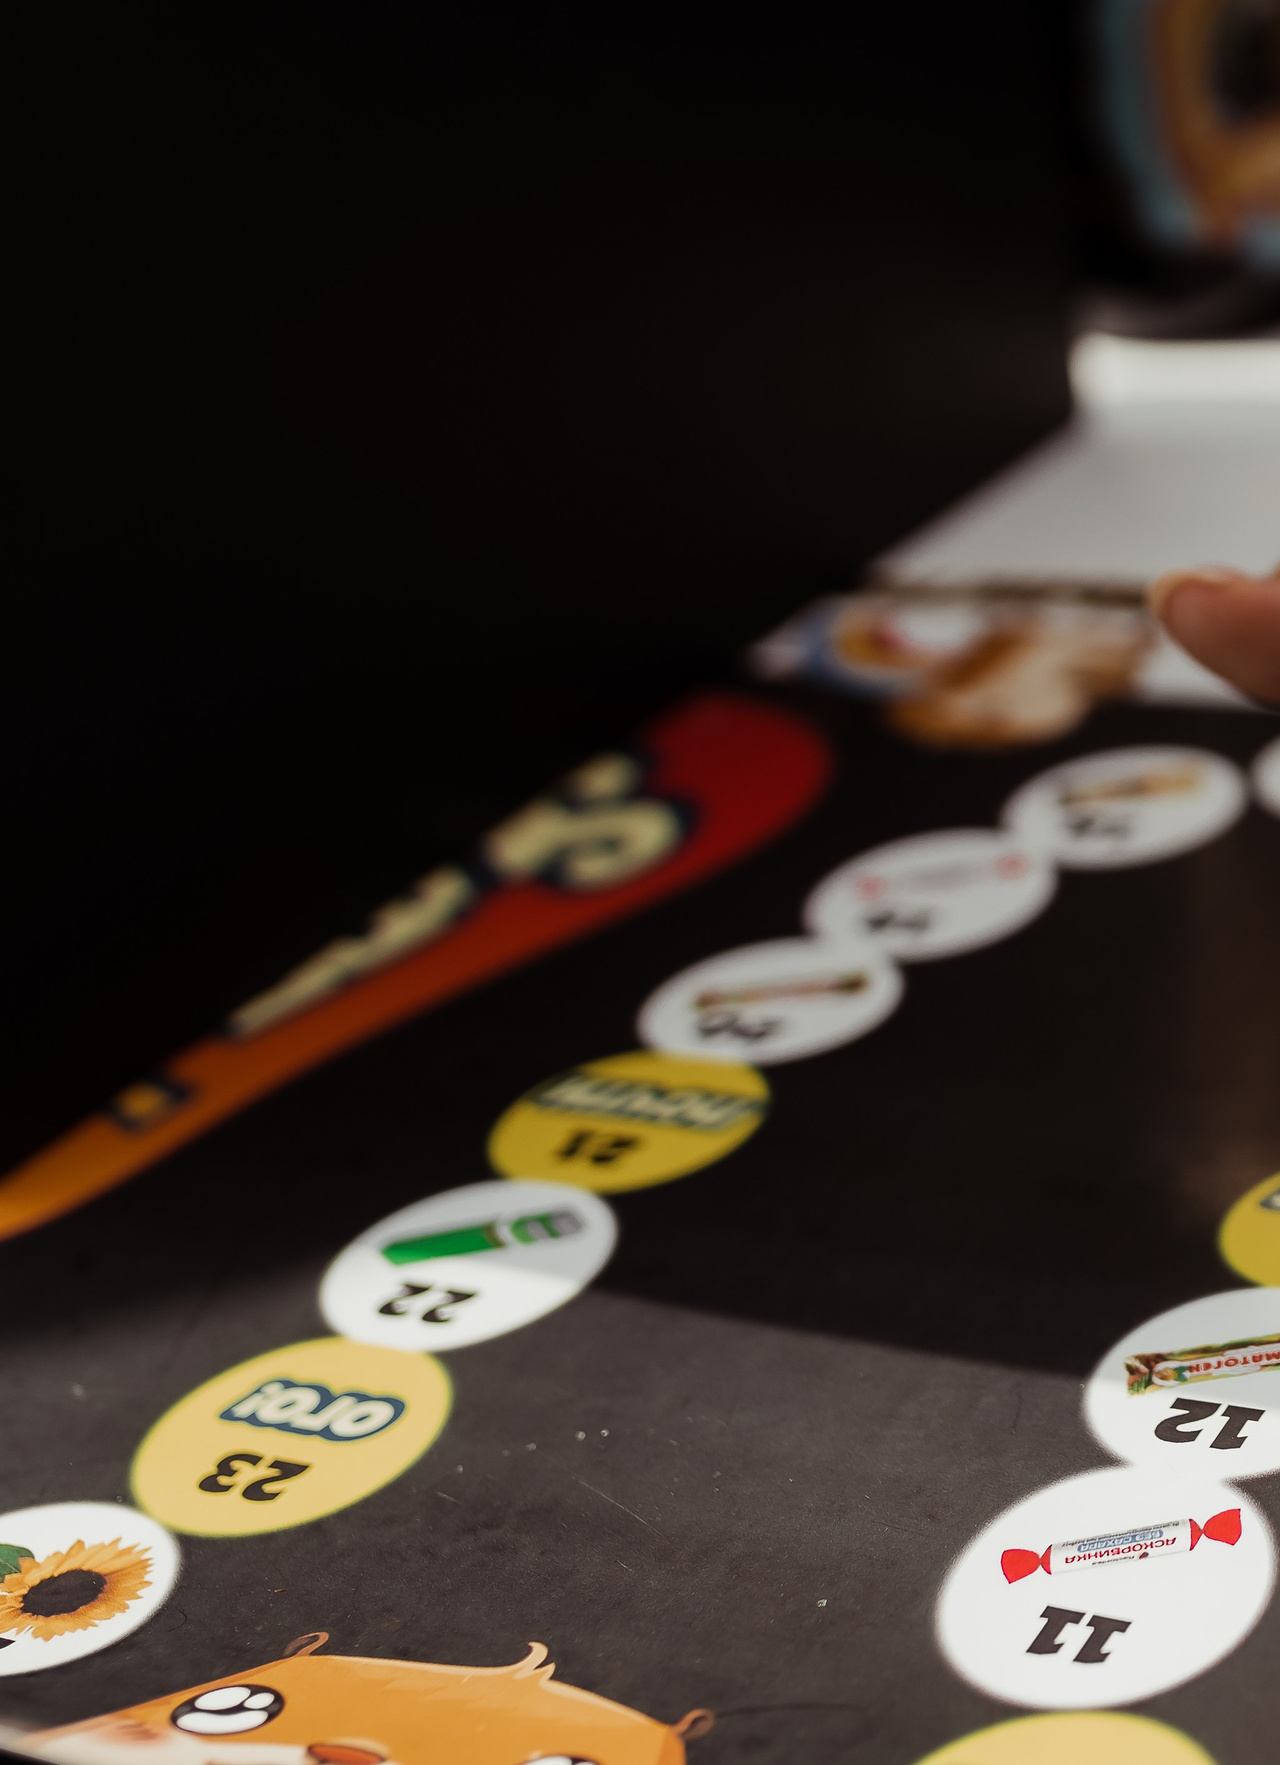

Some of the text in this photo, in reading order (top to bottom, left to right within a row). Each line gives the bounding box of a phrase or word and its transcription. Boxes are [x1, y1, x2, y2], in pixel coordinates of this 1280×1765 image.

[377, 1282, 476, 1325] 22
[227, 1381, 401, 1441] ОГО!
[1154, 1397, 1266, 1450] 12
[197, 1453, 311, 1503] 23
[1064, 1536, 1178, 1565] АСКОРБИНКА
[1025, 1605, 1132, 1664] 11
